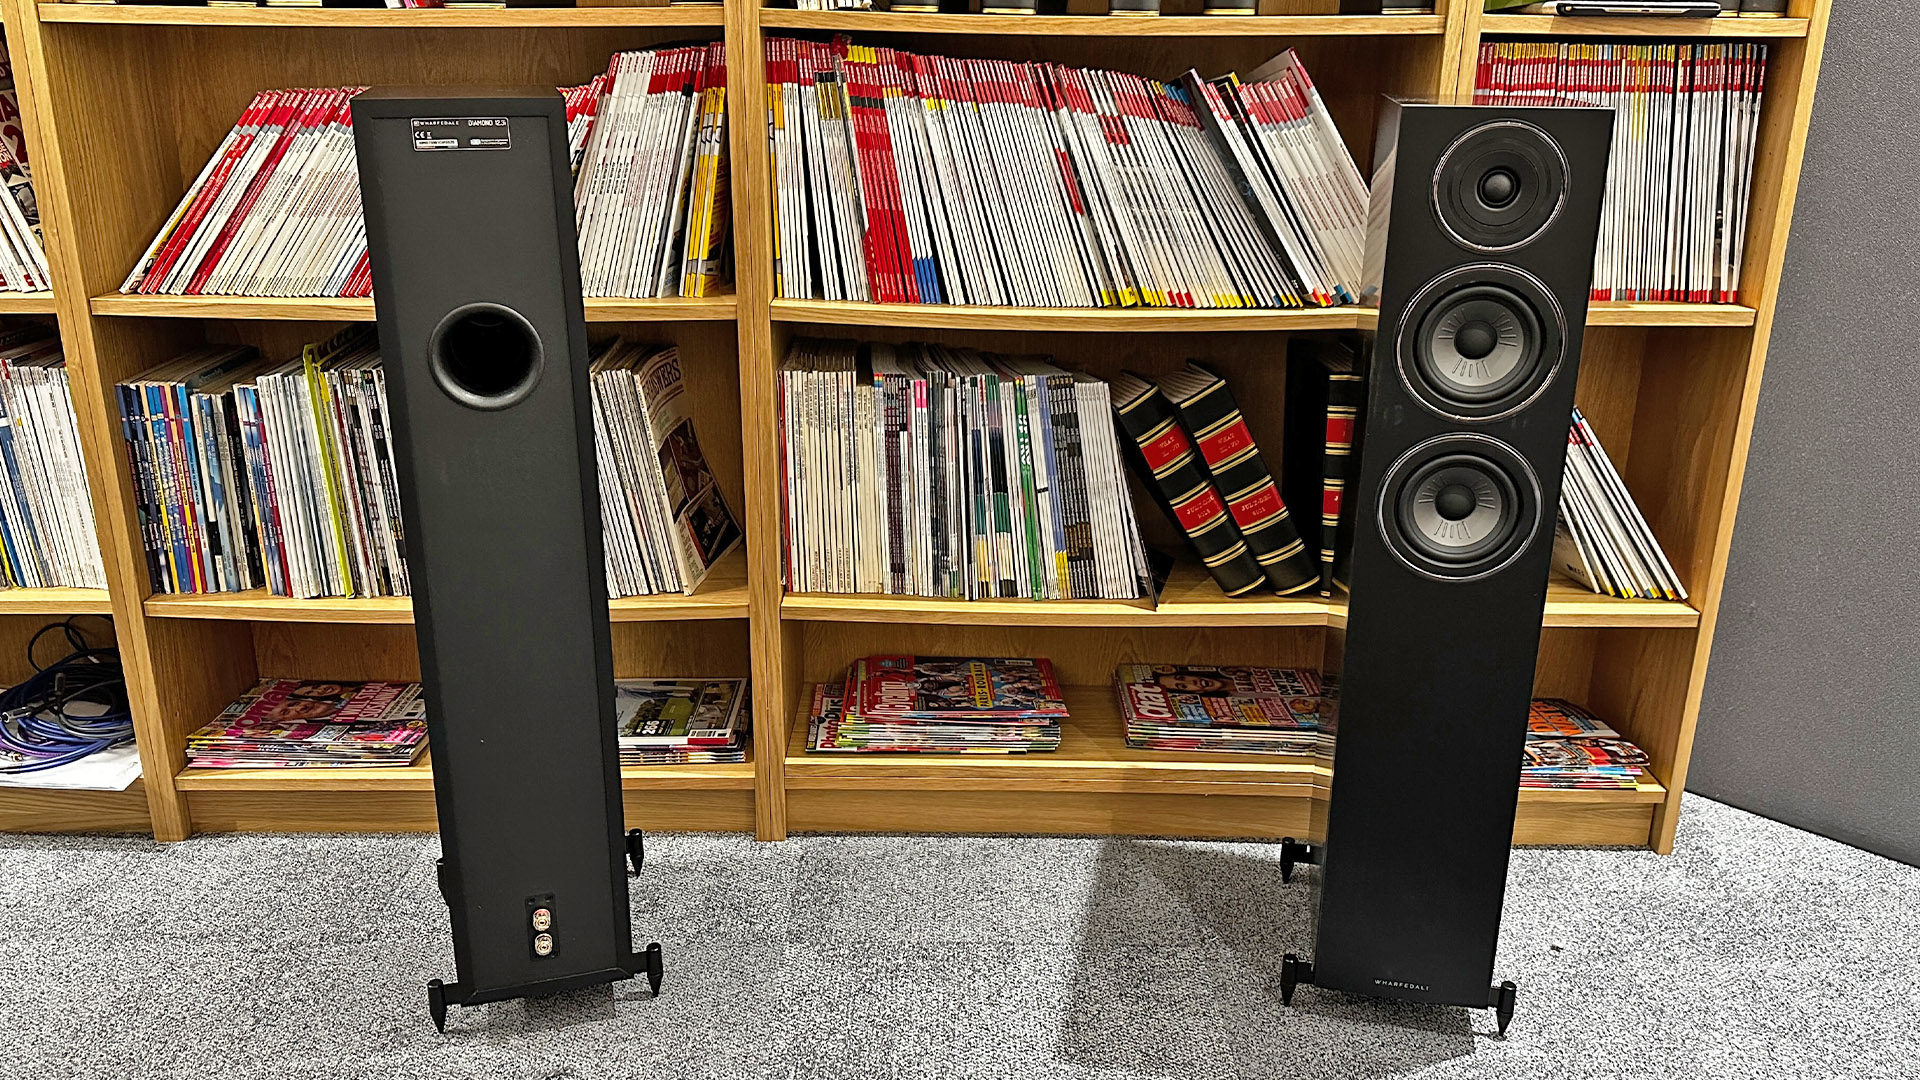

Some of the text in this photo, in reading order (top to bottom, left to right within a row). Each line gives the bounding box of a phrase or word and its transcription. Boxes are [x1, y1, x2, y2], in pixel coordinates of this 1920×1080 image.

[468, 119, 494, 127] DIAMOND
[973, 663, 989, 706] PARIS-ROUBAIX
[1374, 979, 1430, 991] WHARFEDALE
